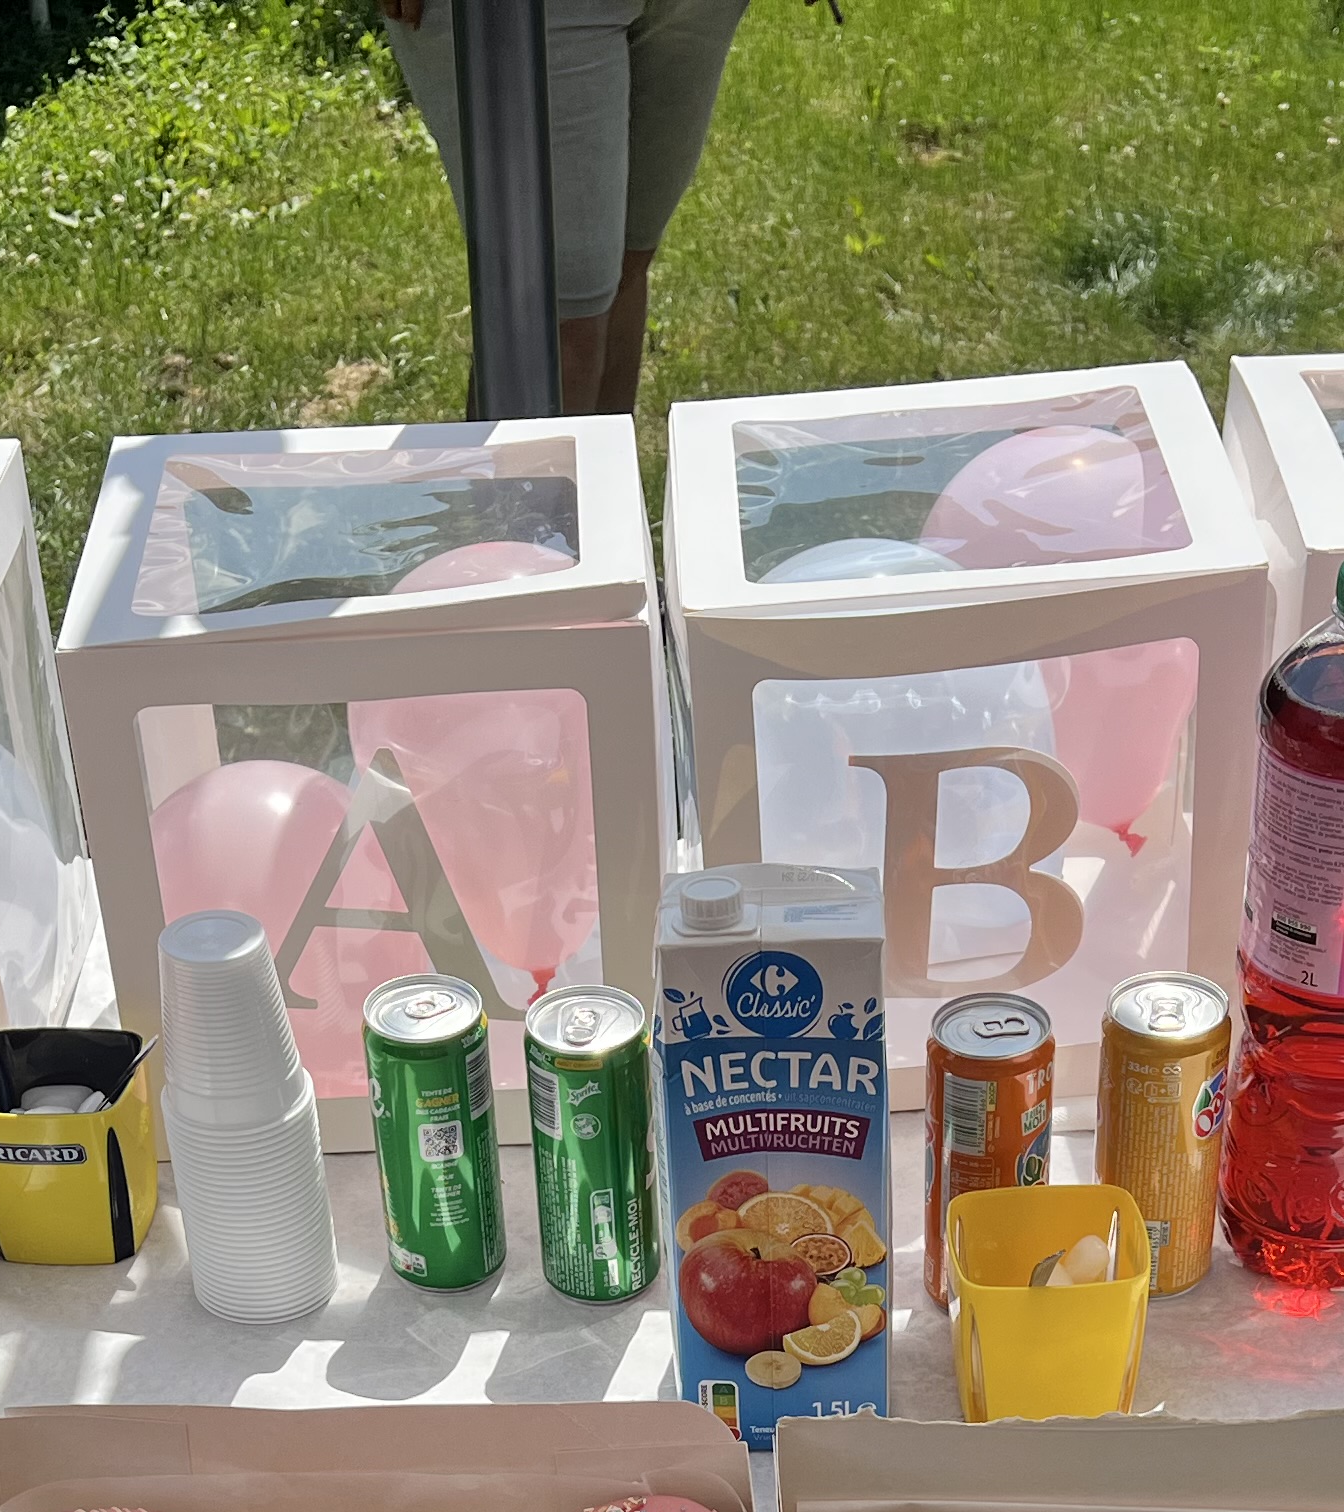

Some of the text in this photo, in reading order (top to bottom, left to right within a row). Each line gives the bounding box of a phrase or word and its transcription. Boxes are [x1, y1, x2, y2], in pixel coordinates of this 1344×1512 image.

[847, 745, 1085, 999] B
[1300, 970, 1318, 988] 2L
[680, 1050, 880, 1098] NECTAR
[570, 1083, 598, 1103] Sprite
[692, 1102, 715, 1114] base
[715, 1096, 728, 1109] de
[706, 1112, 861, 1140] MULTIFRUITS
[710, 1131, 856, 1155] MULTIVRUCHTEN
[626, 1198, 642, 1291] RECYCLE-MOI
